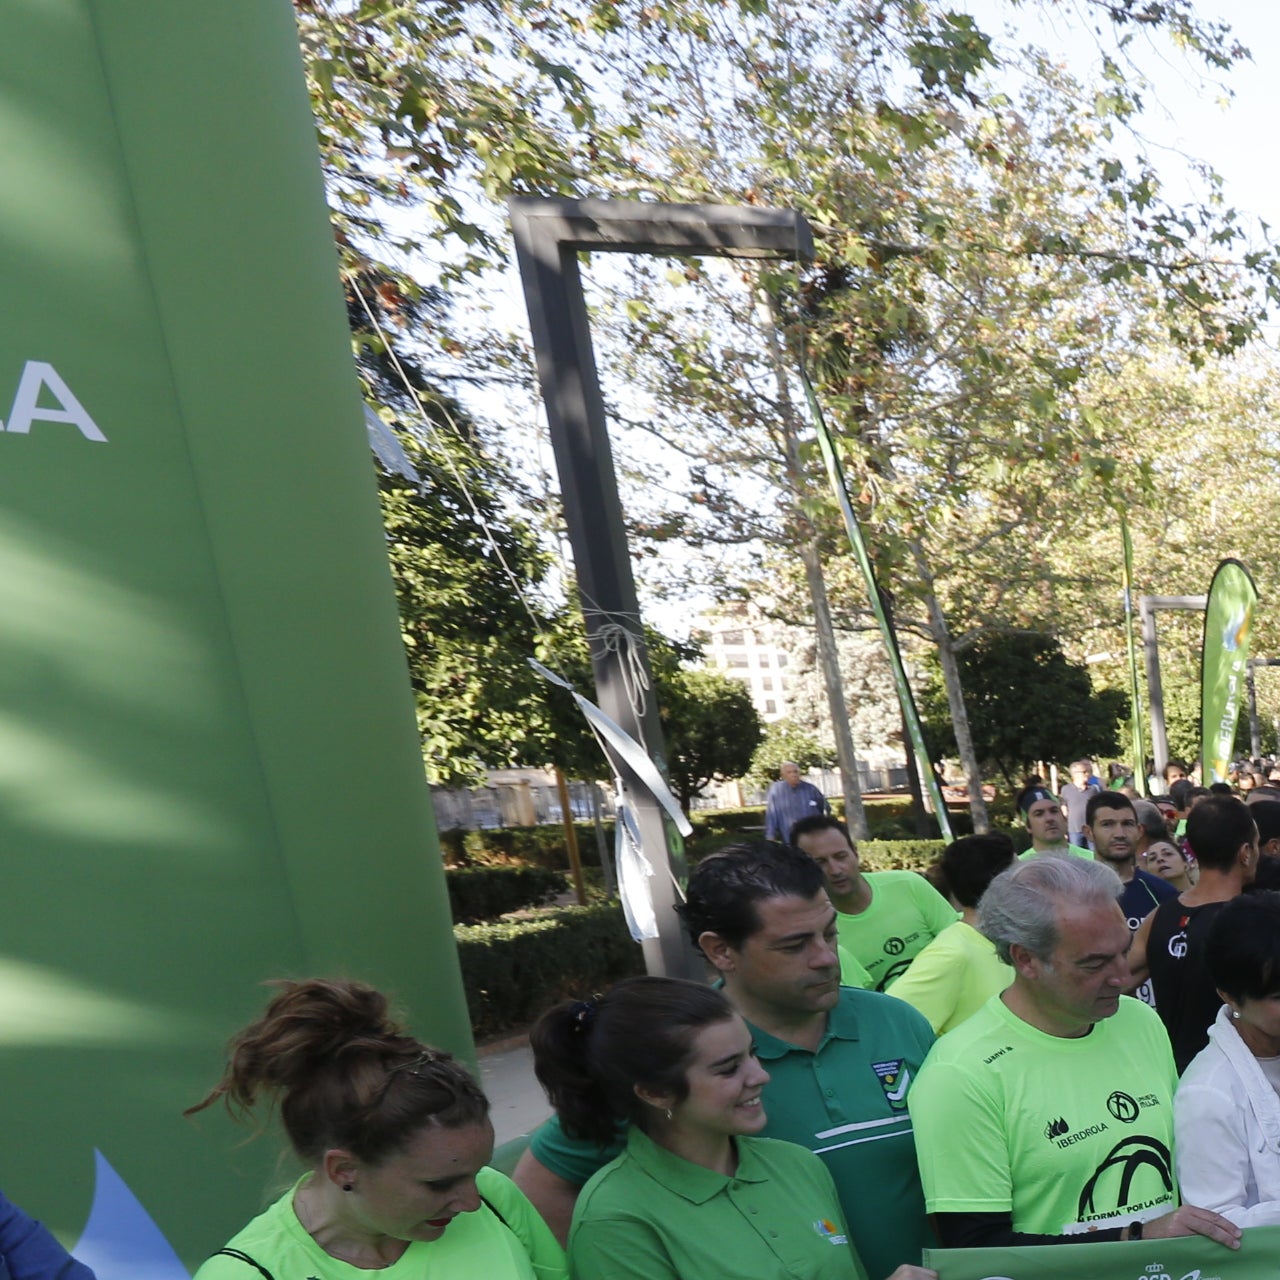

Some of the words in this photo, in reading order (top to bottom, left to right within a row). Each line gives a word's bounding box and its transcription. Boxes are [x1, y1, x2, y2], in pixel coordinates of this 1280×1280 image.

[0, 360, 109, 443] A
[1057, 1122, 1109, 1150] IBERDROLA
[1086, 1210, 1121, 1221] FORMA
[1126, 1203, 1144, 1213] POR
[1143, 1200, 1155, 1208] LA
